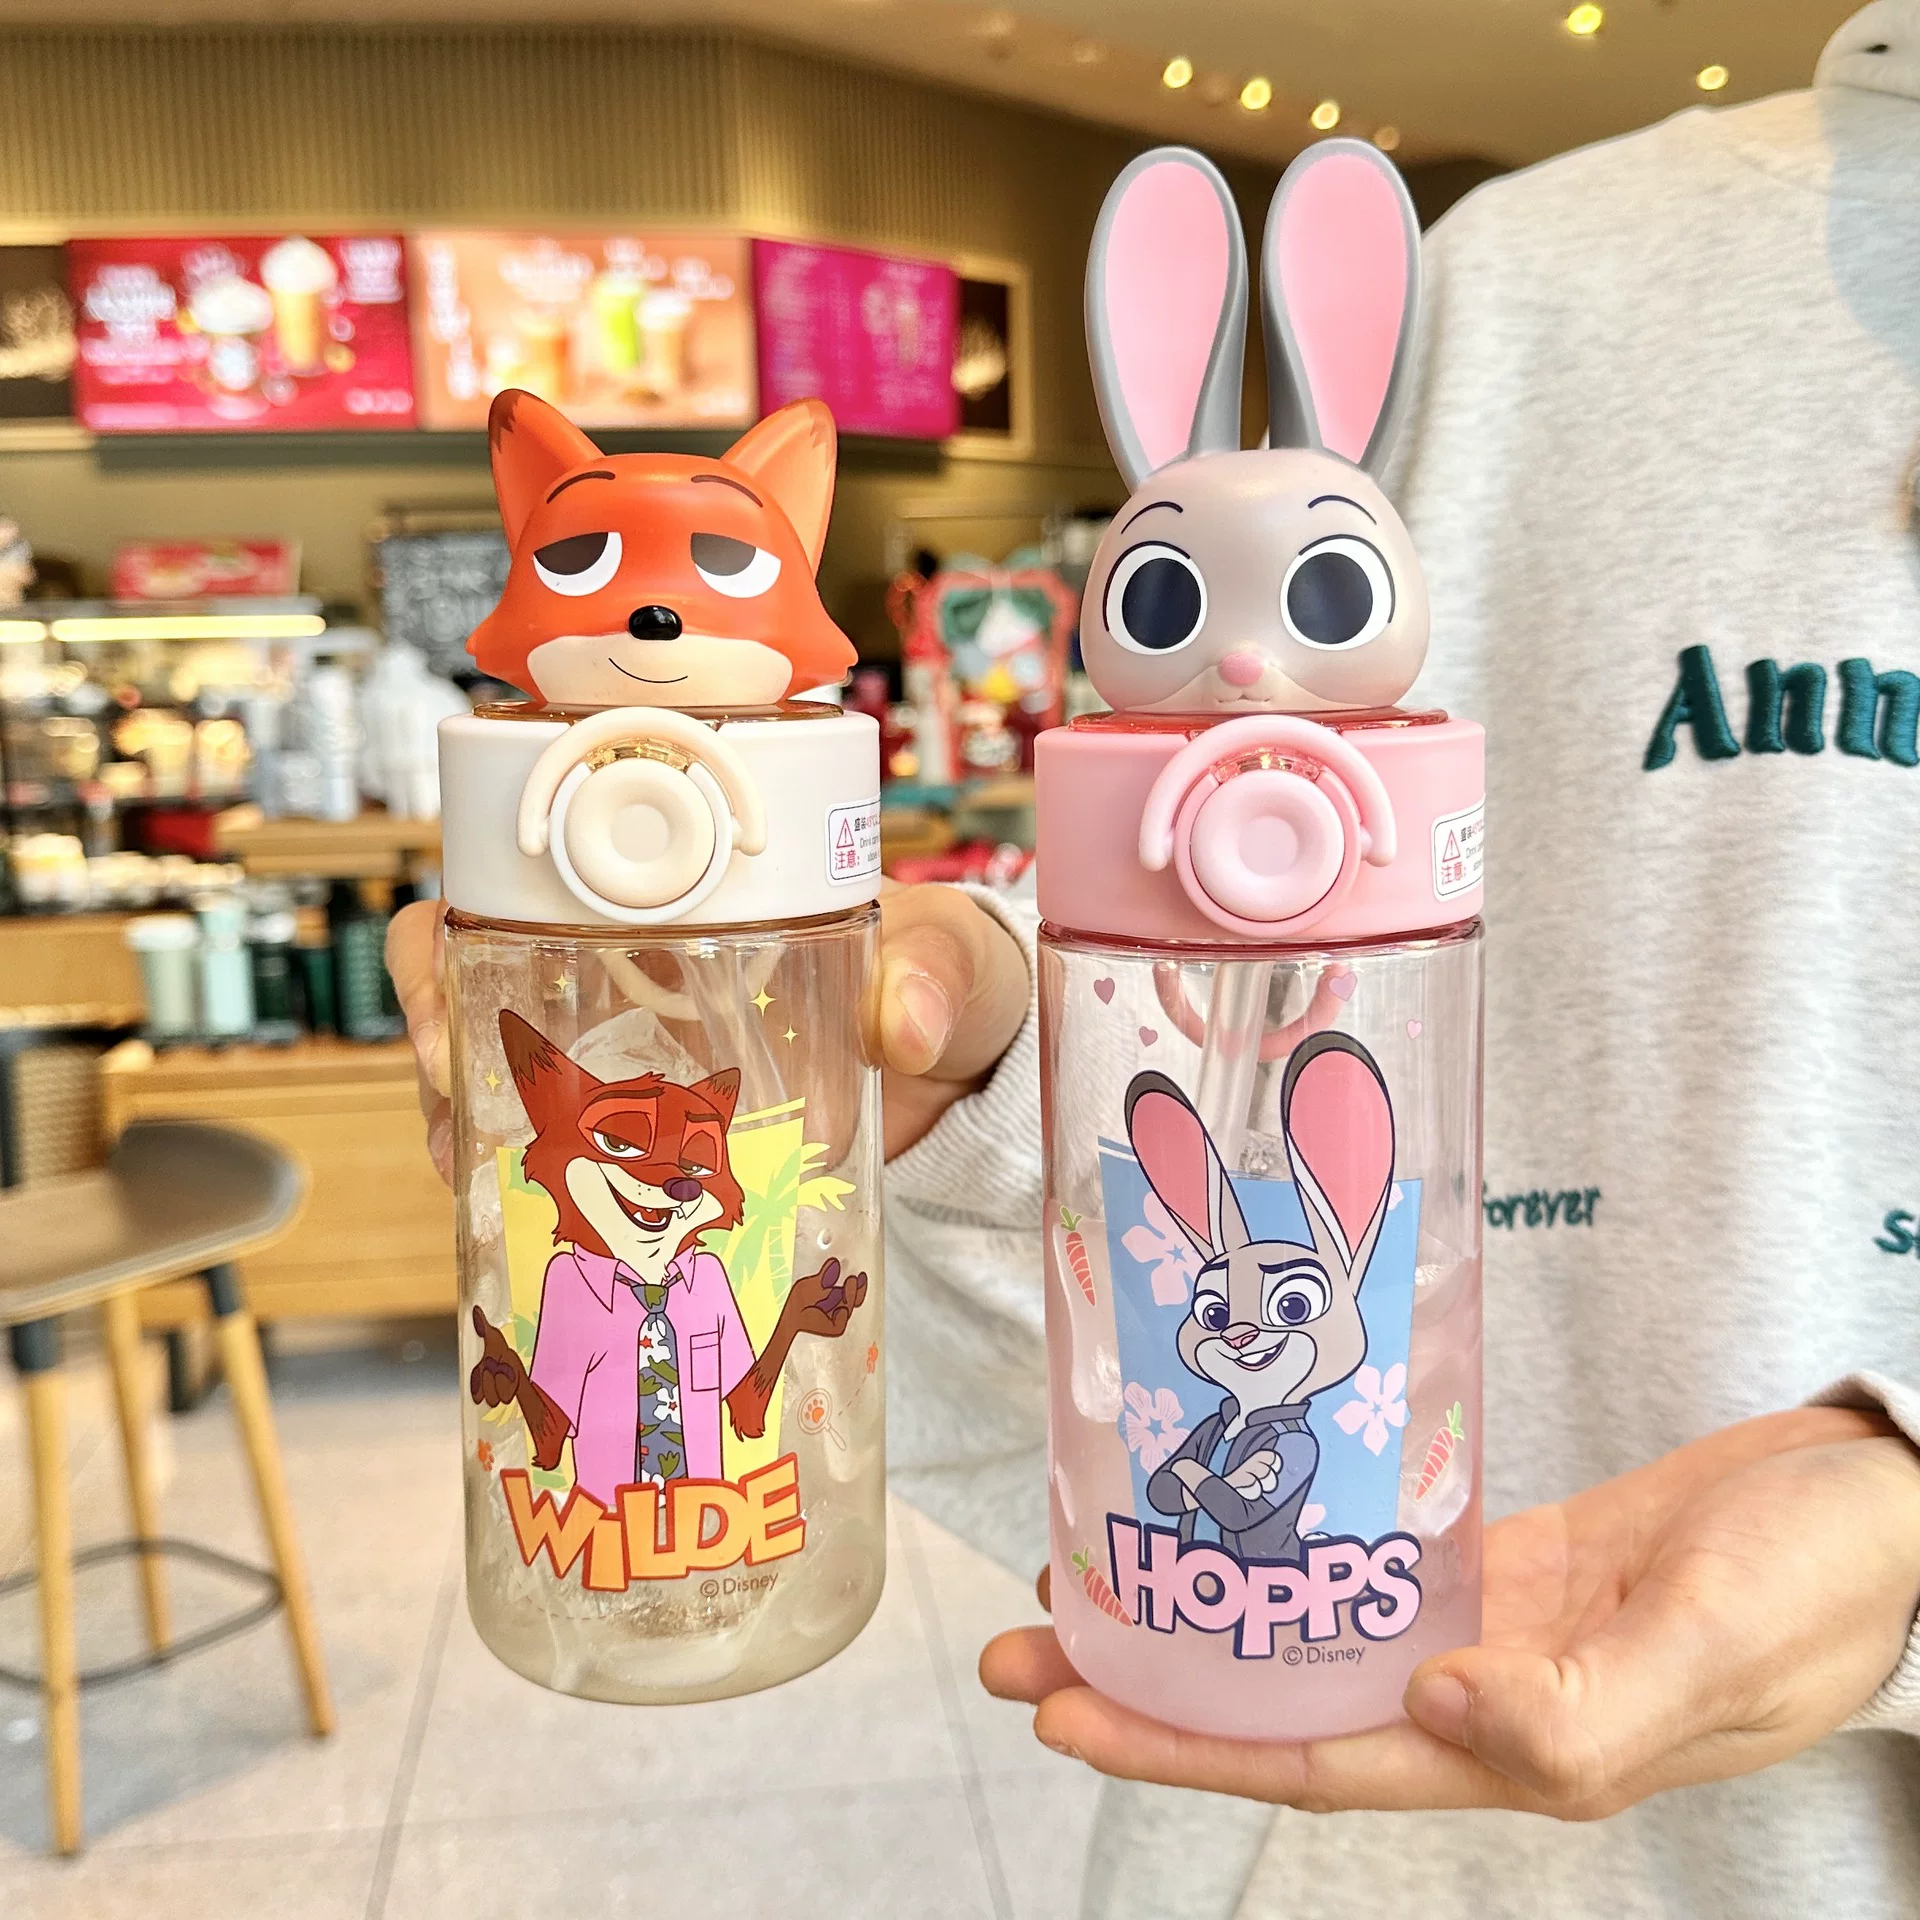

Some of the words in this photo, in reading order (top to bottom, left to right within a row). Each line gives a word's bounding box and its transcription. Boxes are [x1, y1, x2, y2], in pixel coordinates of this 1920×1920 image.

[1482, 1180, 1601, 1230] orever
[500, 1452, 805, 1592] WILDE
[1106, 1512, 1422, 1659] HOPPS
